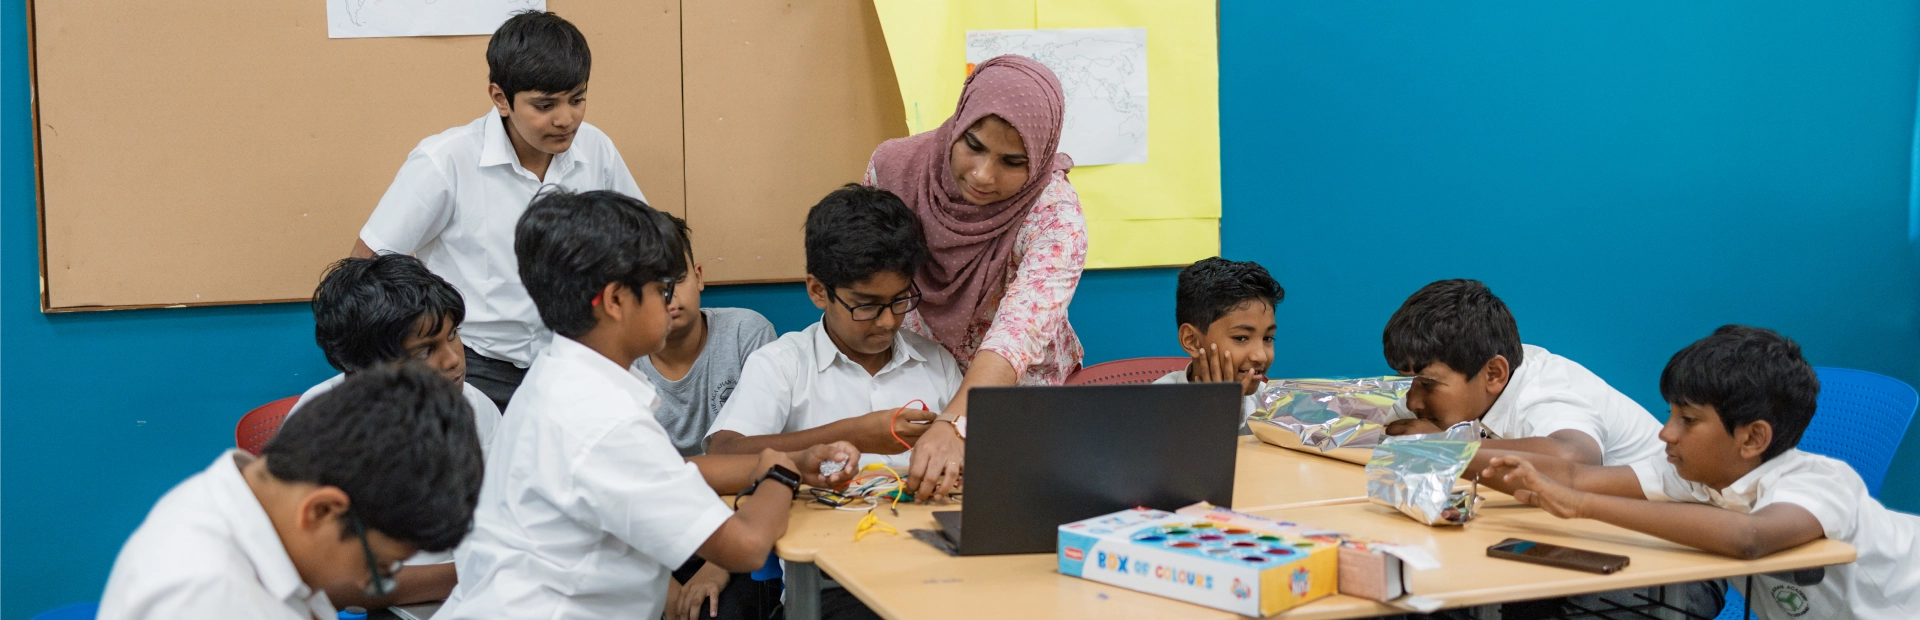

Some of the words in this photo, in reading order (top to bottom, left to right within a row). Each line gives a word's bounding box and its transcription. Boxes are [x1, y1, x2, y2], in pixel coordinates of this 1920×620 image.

[717, 380, 732, 390] KHAN
[1098, 551, 1128, 573] BOX
[1134, 560, 1149, 575] OF
[1155, 565, 1213, 589] COLOURS
